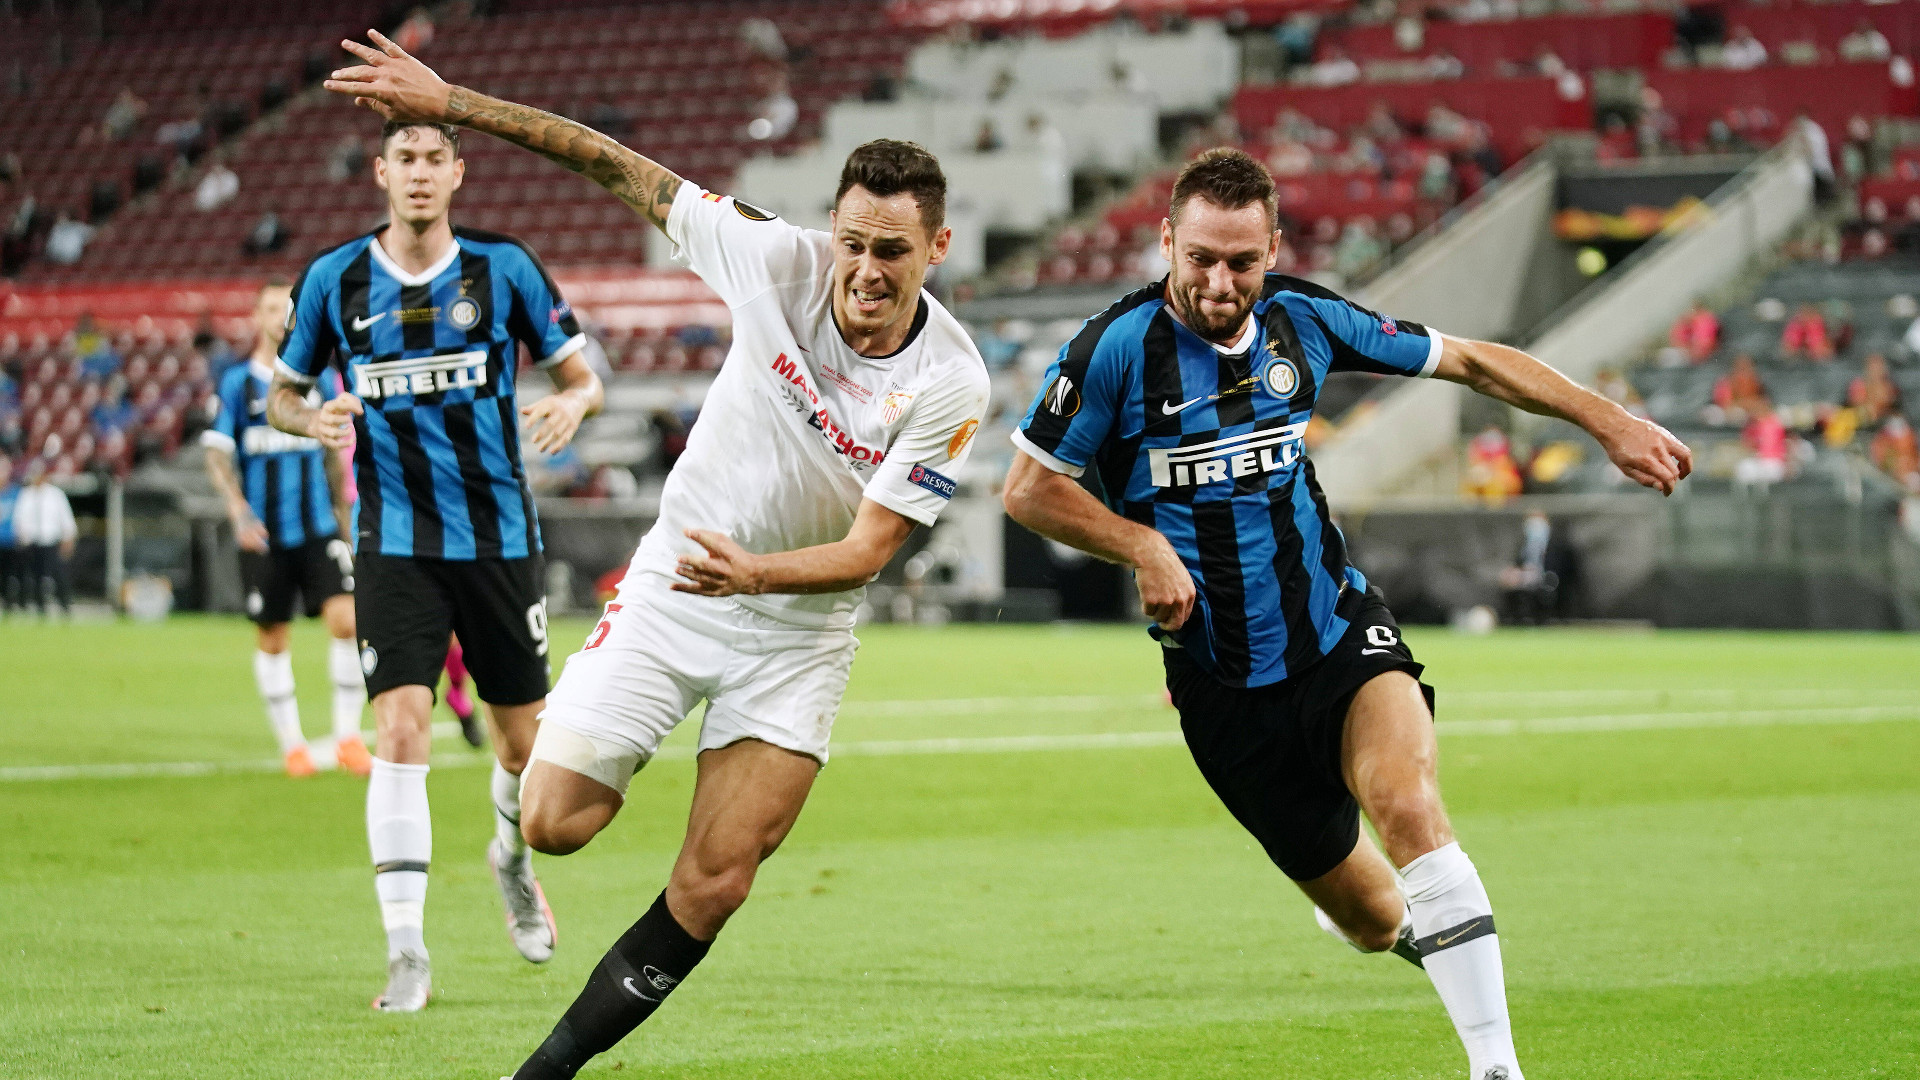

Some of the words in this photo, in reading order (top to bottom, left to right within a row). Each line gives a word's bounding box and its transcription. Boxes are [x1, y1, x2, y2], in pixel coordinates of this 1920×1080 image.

[353, 350, 487, 398] PIRELLI
[836, 373, 860, 389] COLOGNE
[860, 387, 873, 397] 2020
[923, 473, 956, 495] RESPECT
